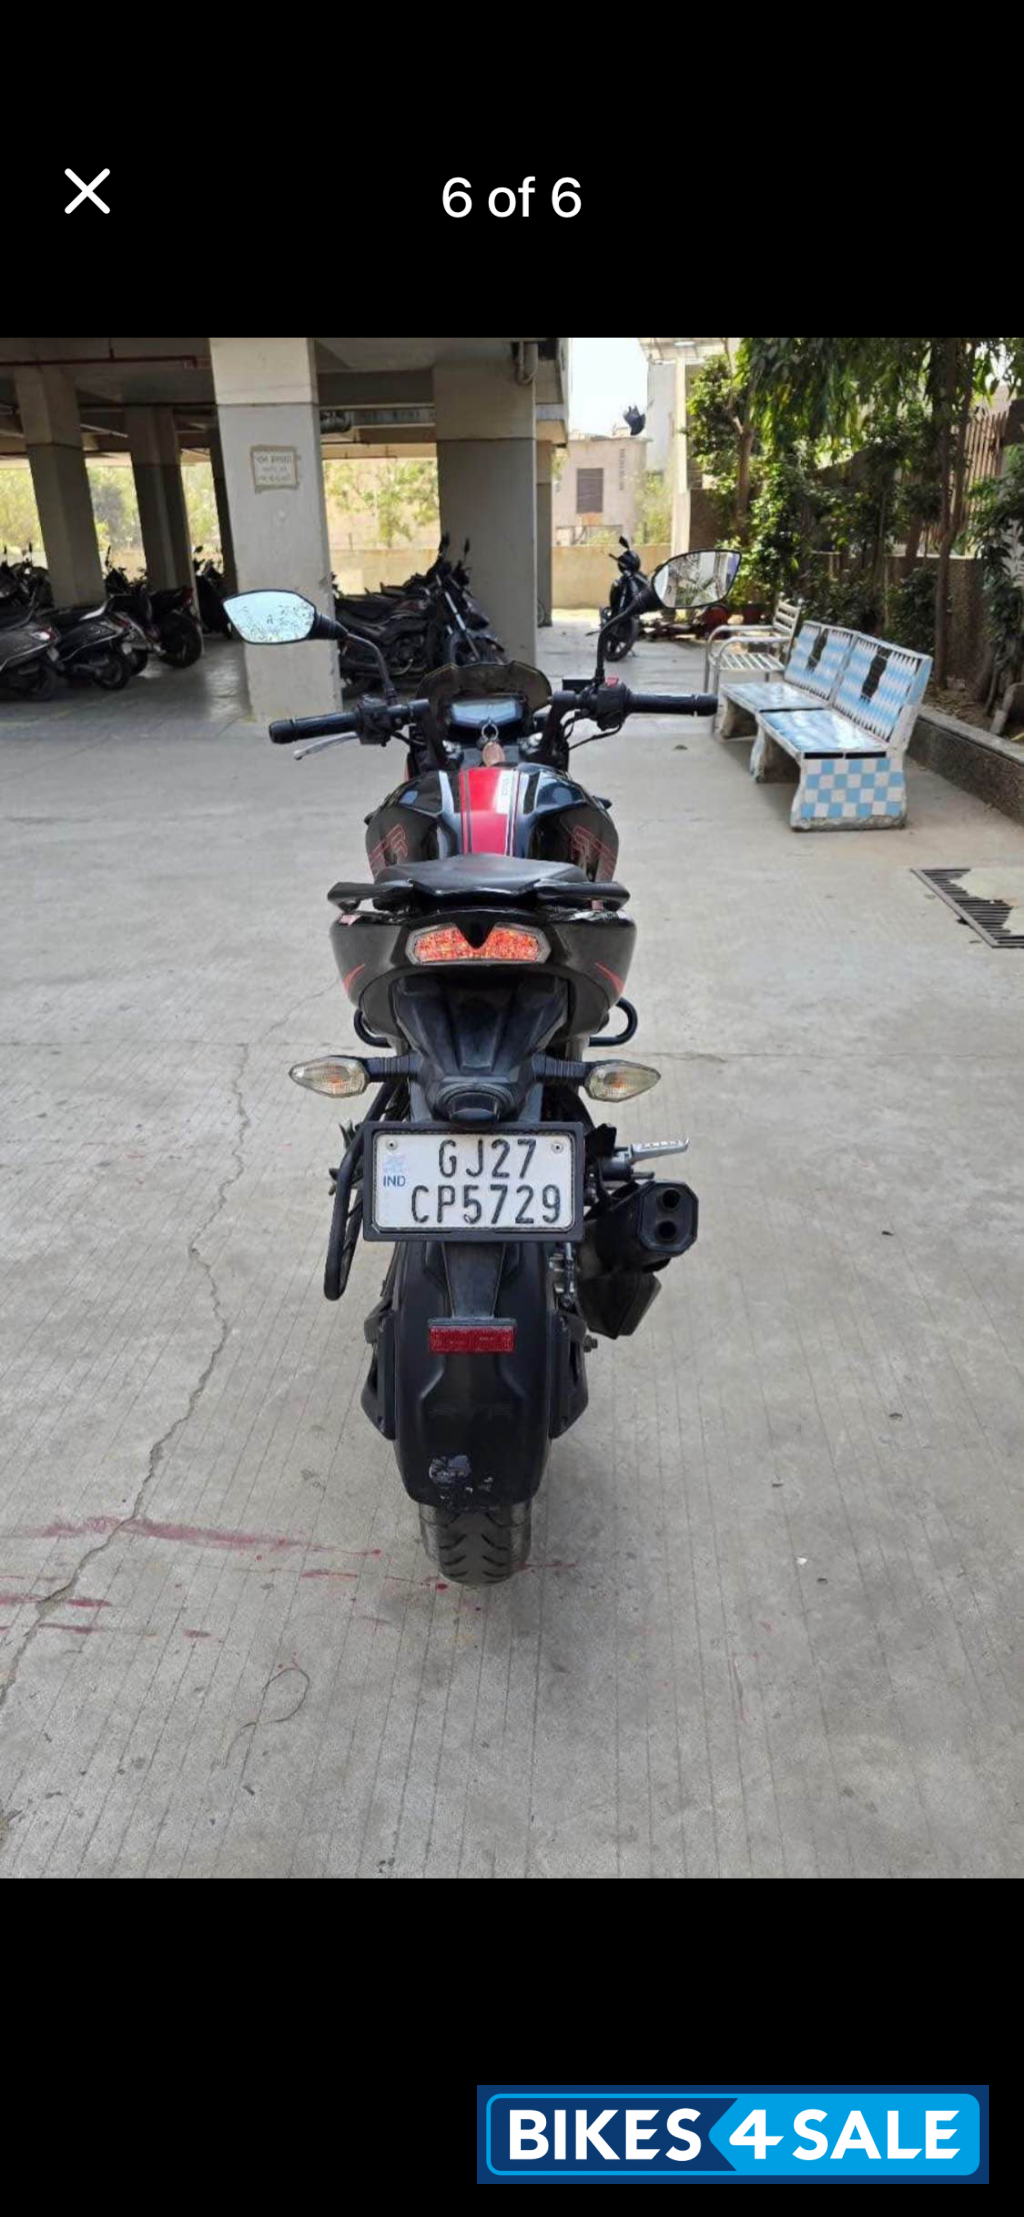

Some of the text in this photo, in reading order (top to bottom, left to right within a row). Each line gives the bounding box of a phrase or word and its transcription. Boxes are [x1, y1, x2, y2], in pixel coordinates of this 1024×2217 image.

[438, 1139, 537, 1179] GJ27
[383, 1175, 406, 1187] IND
[411, 1184, 561, 1224] CP5729
